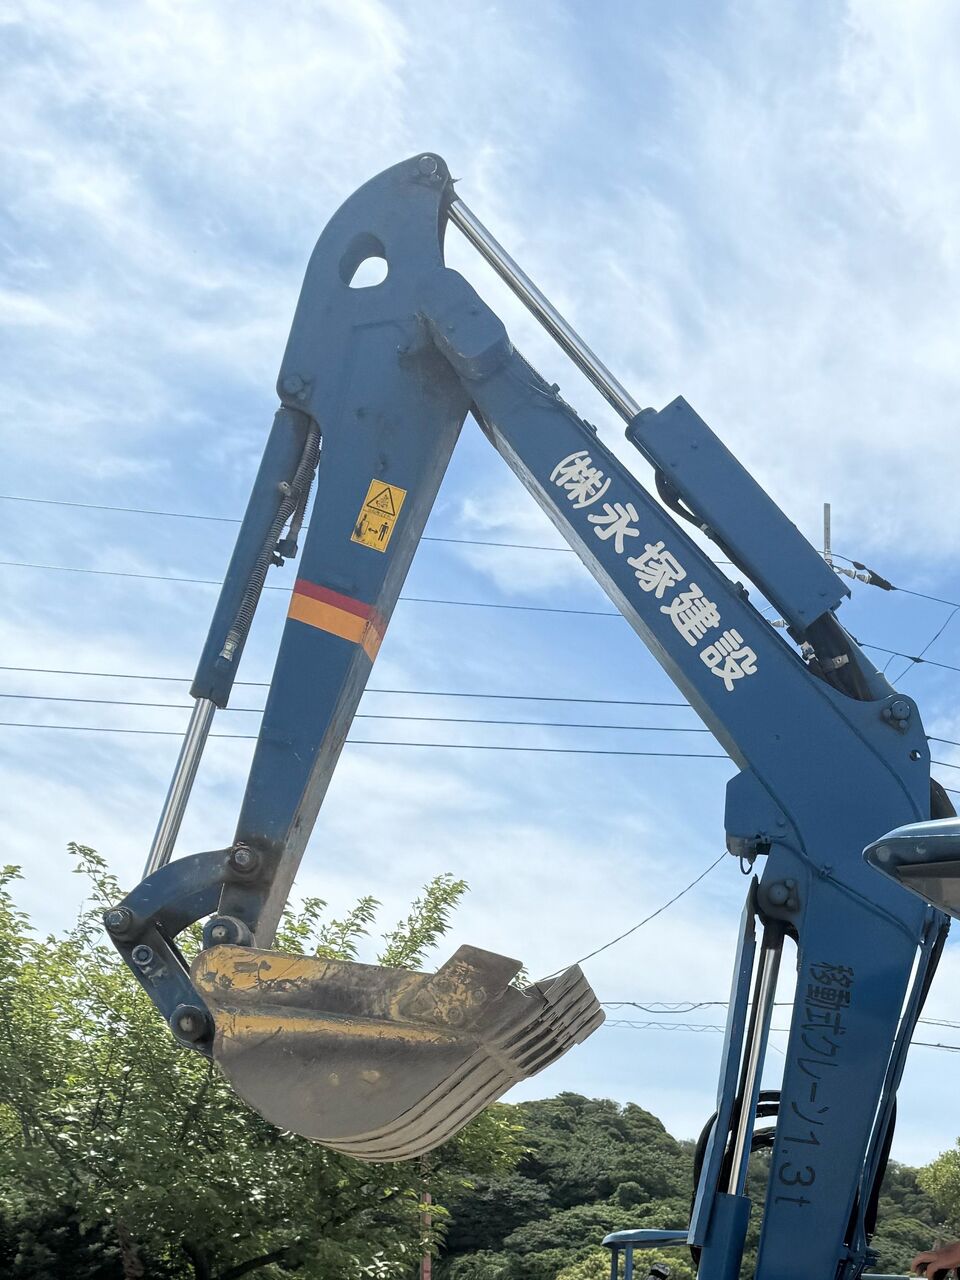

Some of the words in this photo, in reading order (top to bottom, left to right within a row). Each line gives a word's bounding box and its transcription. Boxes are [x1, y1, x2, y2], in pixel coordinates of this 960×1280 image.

[550, 450, 758, 692] (株)永塚建設
